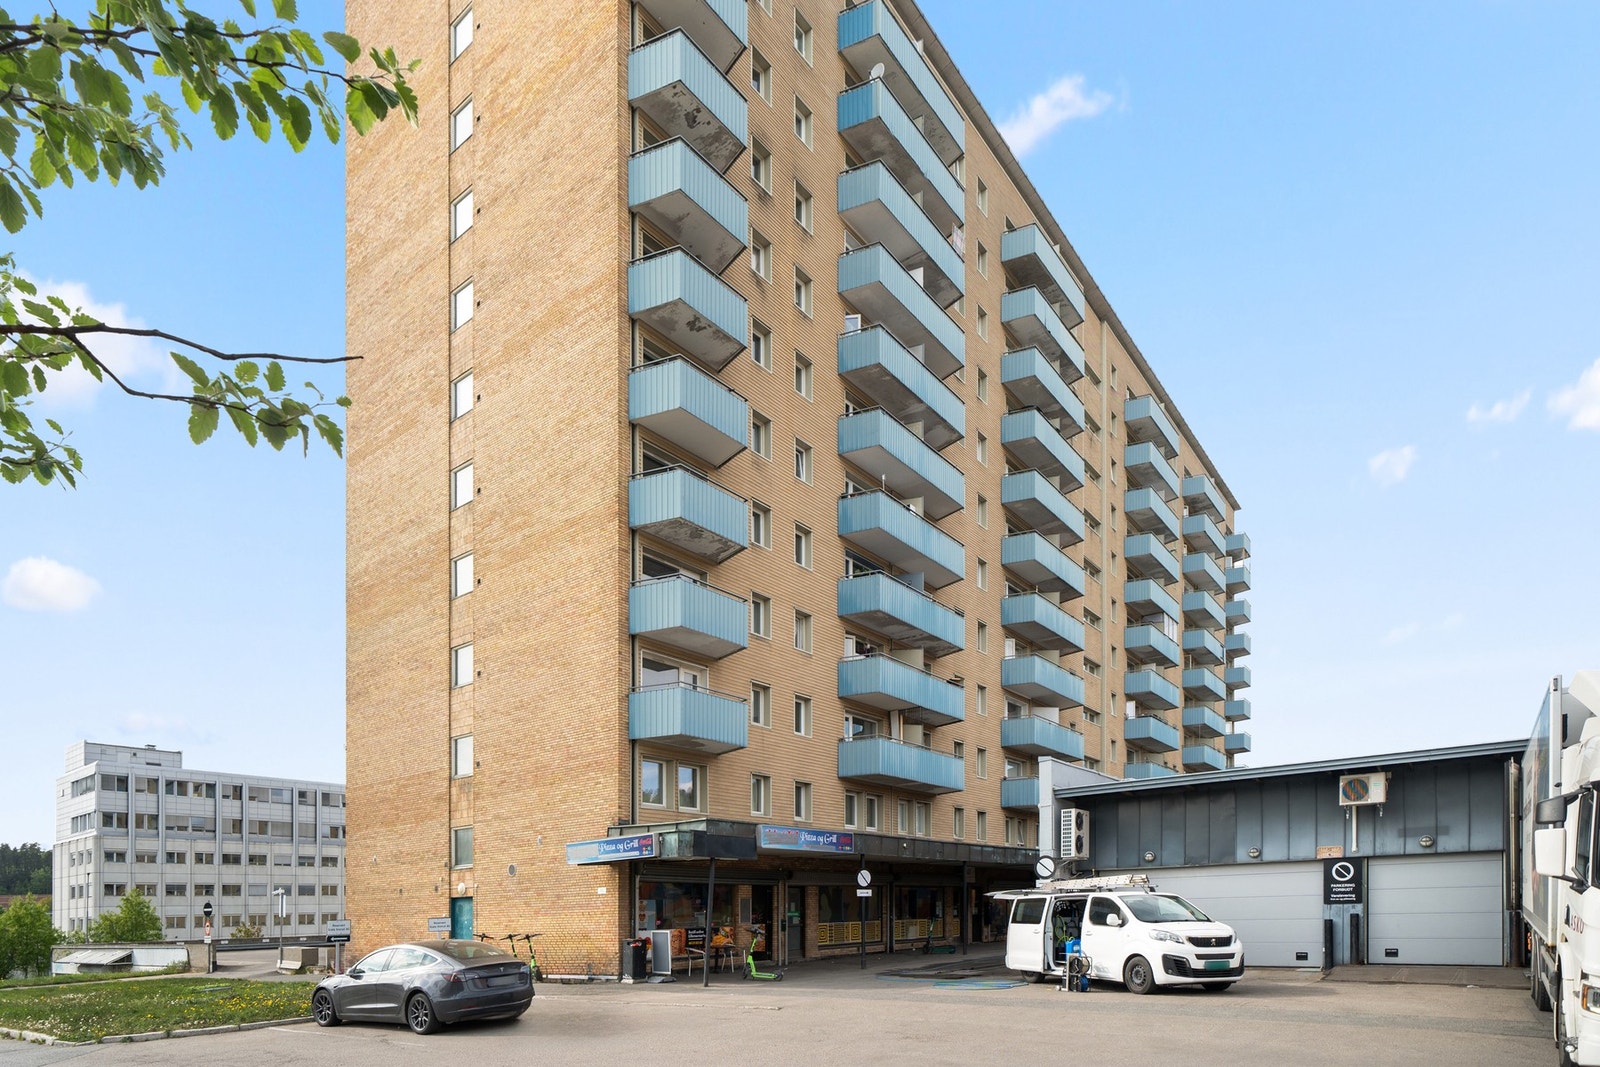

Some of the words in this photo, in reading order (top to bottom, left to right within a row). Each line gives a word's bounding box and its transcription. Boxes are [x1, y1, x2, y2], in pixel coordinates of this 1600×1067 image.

[800, 831, 817, 841] Pizza
[817, 835, 824, 845] og
[824, 833, 838, 844] Grill
[600, 842, 616, 852] Pizza
[616, 843, 624, 852] og
[624, 839, 639, 850] Grill
